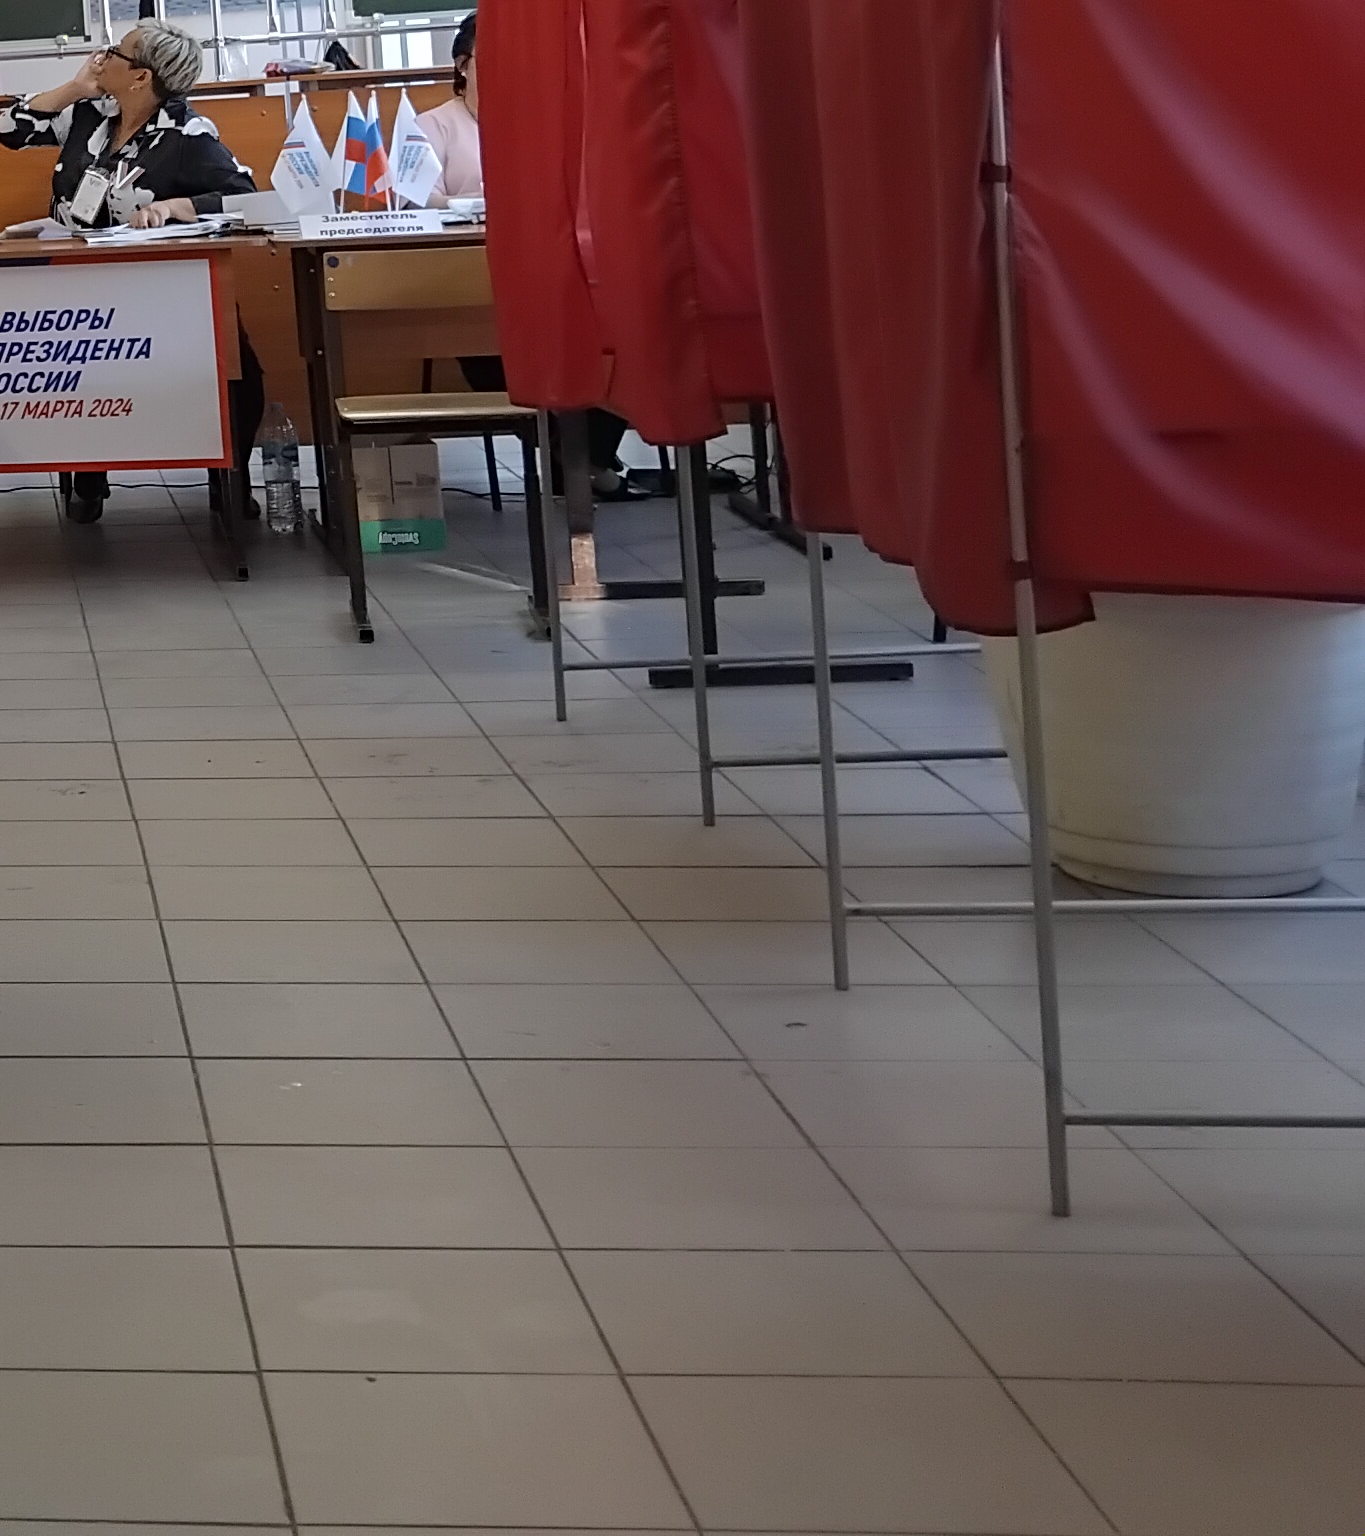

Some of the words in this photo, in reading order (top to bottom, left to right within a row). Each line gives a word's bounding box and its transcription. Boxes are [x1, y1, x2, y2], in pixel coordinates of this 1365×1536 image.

[321, 212, 417, 223] Заместитель
[319, 225, 424, 237] председателя
[20, 400, 85, 419] МАРТА
[87, 397, 133, 418] 2024
